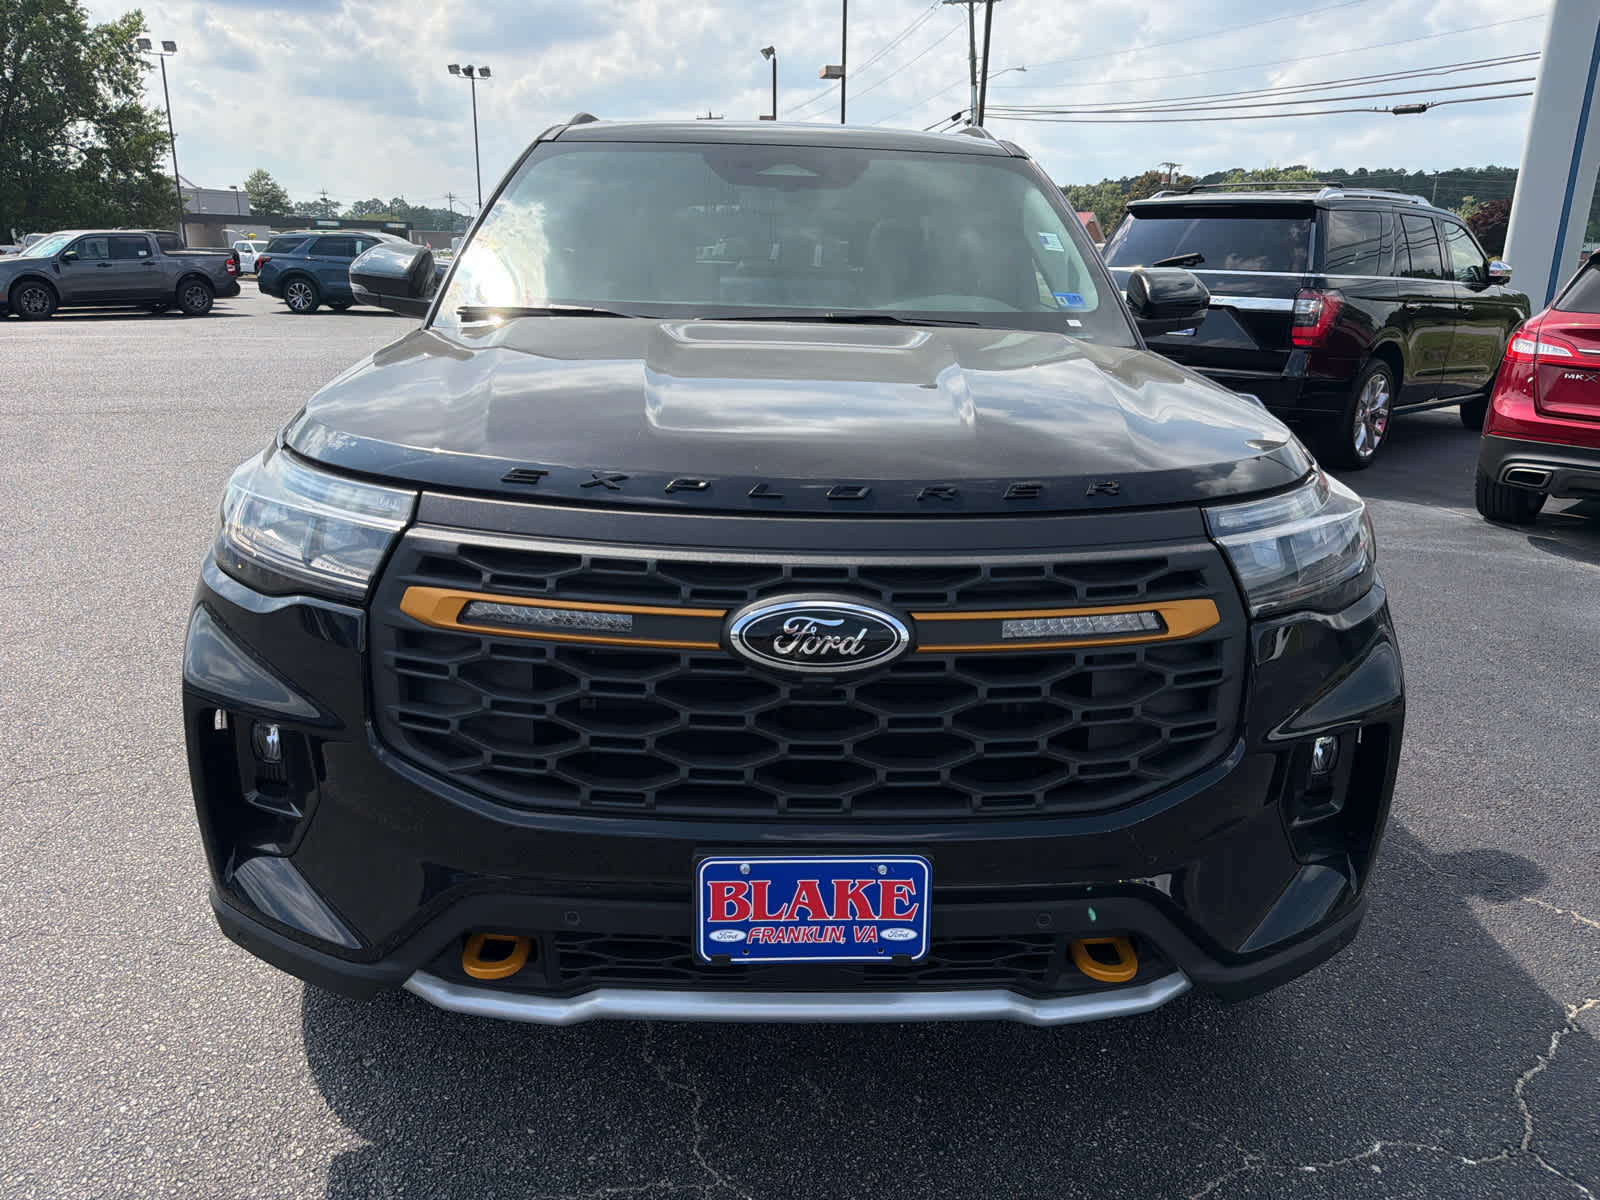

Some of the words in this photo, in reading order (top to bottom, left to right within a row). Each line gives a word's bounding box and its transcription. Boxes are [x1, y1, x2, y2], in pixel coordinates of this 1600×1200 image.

[1564, 372, 1599, 383] MKX
[500, 467, 1122, 501] EXPLORER
[773, 616, 868, 656] Ford
[707, 878, 919, 922] BLAKE
[746, 925, 847, 944] FRANKLIN,
[853, 925, 878, 943] VA
